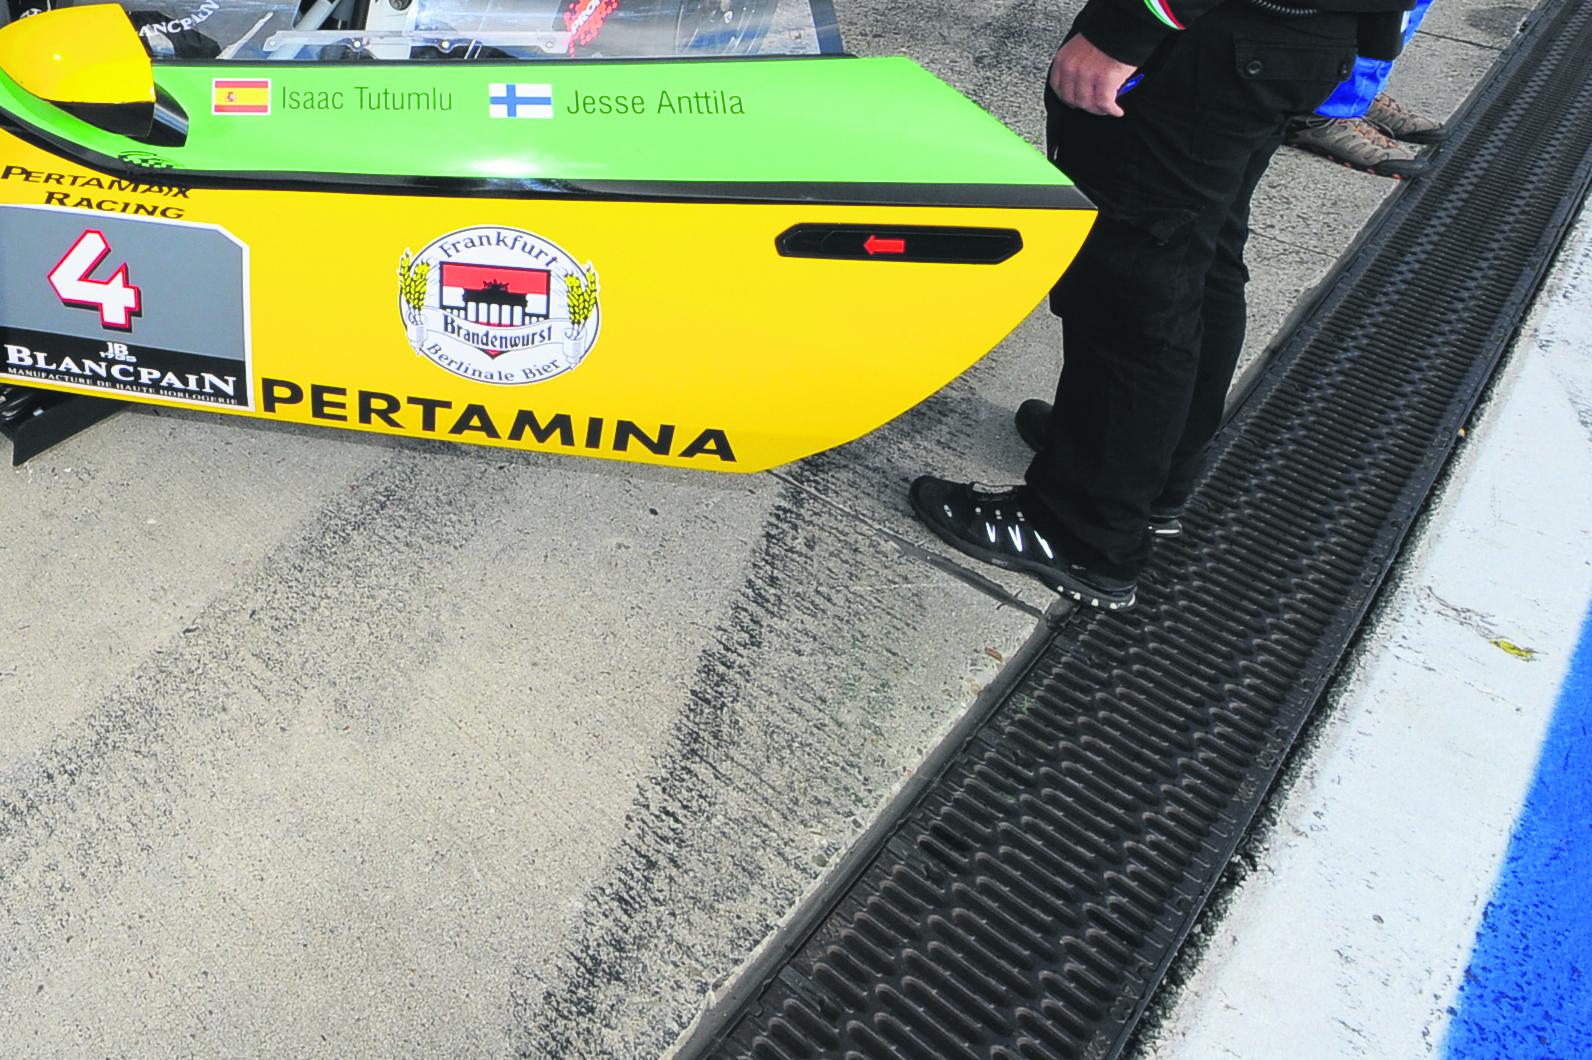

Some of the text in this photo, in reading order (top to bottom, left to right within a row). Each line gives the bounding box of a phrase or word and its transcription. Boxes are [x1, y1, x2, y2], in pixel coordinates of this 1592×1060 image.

[281, 85, 453, 113] Isaac Tutumlu
[567, 89, 746, 116] Jesse Anttila
[44, 190, 186, 220] RACING
[438, 230, 559, 268] Frankfurt
[46, 228, 143, 333] 4
[443, 313, 553, 350] Brandenwurst
[3, 343, 237, 397] BLANCPAIN
[426, 341, 561, 382] Berlinale Bier
[8, 367, 238, 405] MANUFACTURE DE HAUTE HORLOGERIE
[261, 377, 737, 463] PERTAMINA
